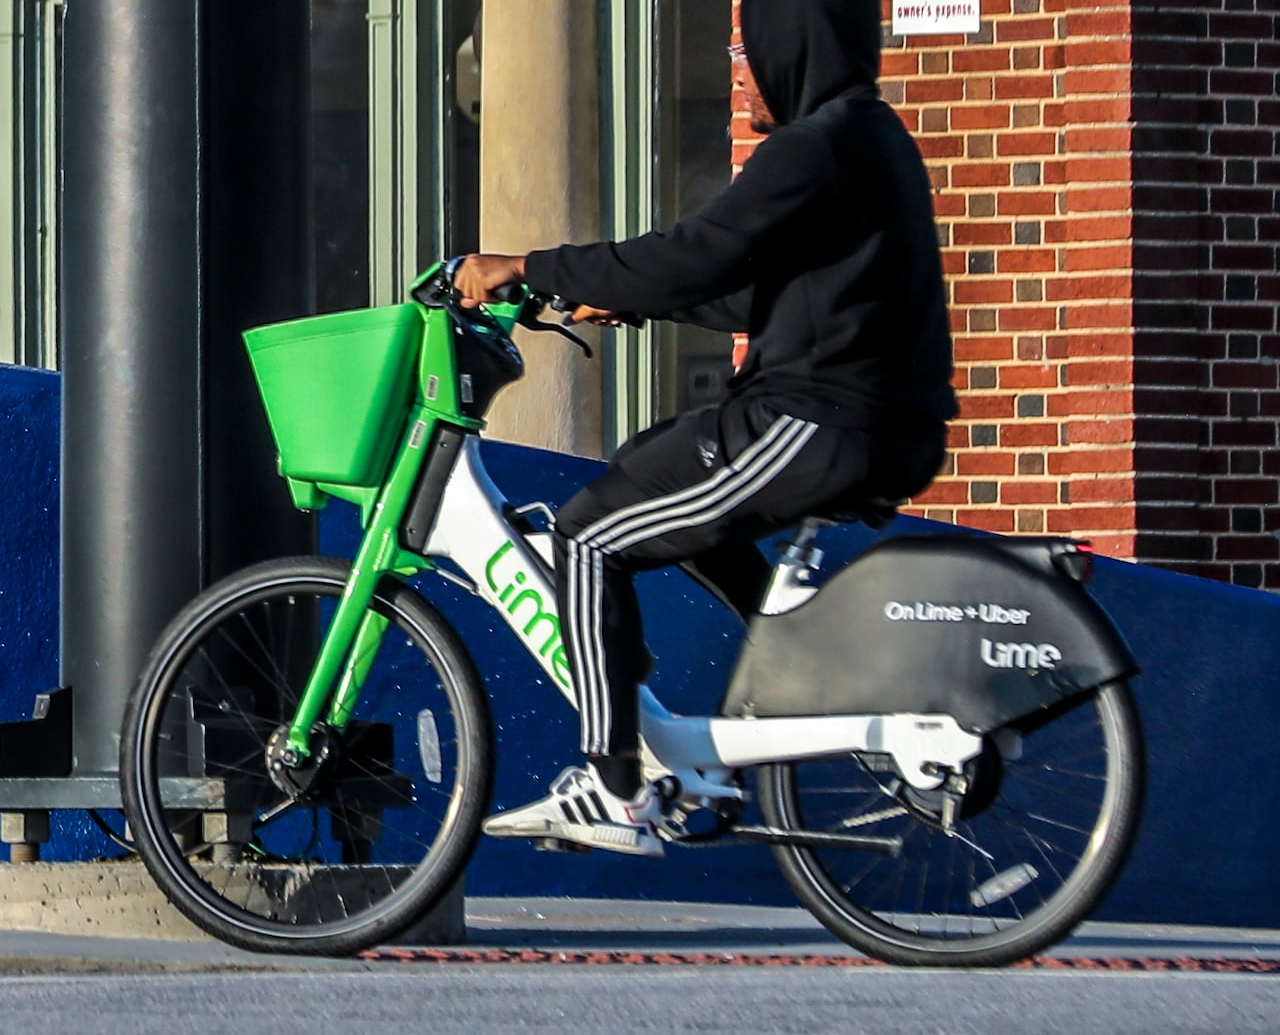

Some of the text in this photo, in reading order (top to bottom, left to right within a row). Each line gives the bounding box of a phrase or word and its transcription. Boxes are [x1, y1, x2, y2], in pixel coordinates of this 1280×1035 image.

[897, 1, 932, 19] owner's
[884, 601, 915, 621] On
[915, 602, 965, 622] Lime
[979, 603, 1031, 625] Uber
[981, 638, 1063, 669] Lime
